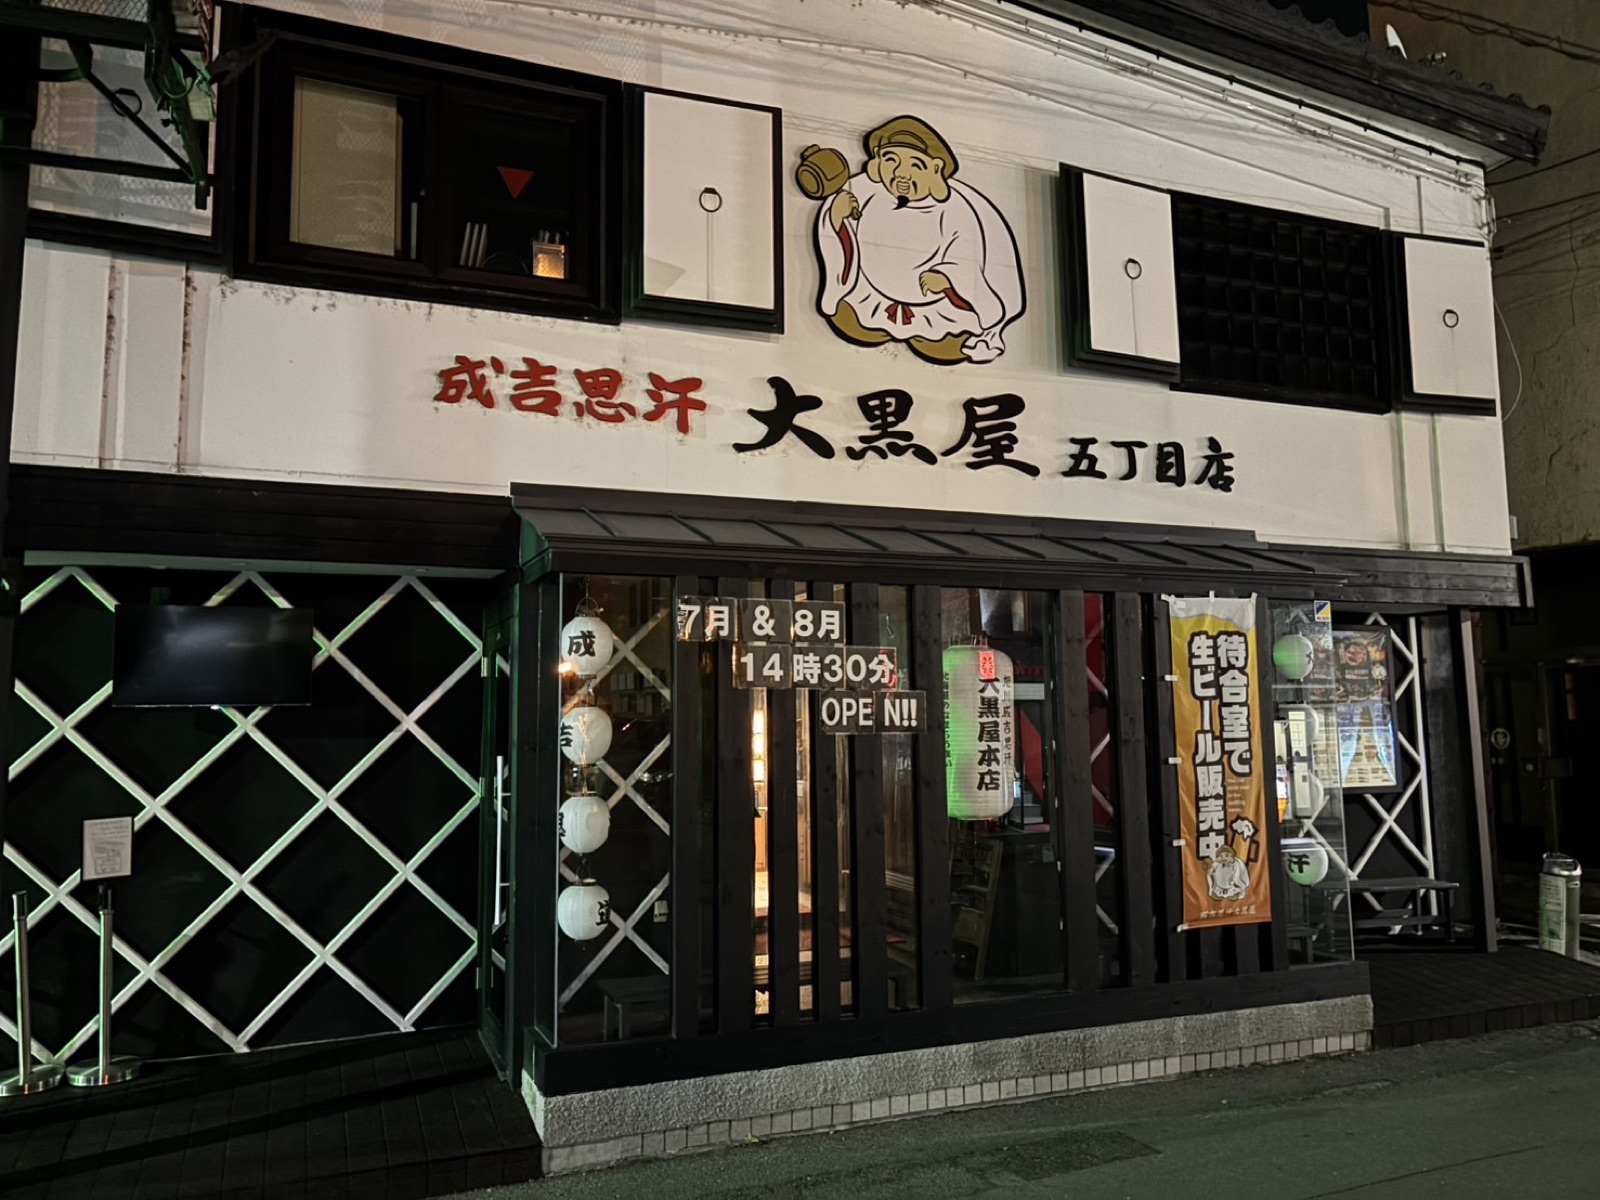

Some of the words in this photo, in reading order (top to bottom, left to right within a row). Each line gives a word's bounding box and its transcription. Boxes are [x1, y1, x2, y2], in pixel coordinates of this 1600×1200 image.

[433, 354, 709, 435] 成吉思汗
[733, 376, 1040, 477] 大黒屋
[1061, 435, 1235, 493] 五丁目店
[567, 630, 596, 657] 成
[684, 604, 729, 637] 7月
[752, 604, 776, 637] &
[794, 609, 840, 640] 8月
[740, 651, 895, 684] 14時30分
[977, 677, 1001, 792] 大黒屋本店
[1191, 633, 1226, 861] 生ビール販売中
[1217, 633, 1251, 774] 待合室で
